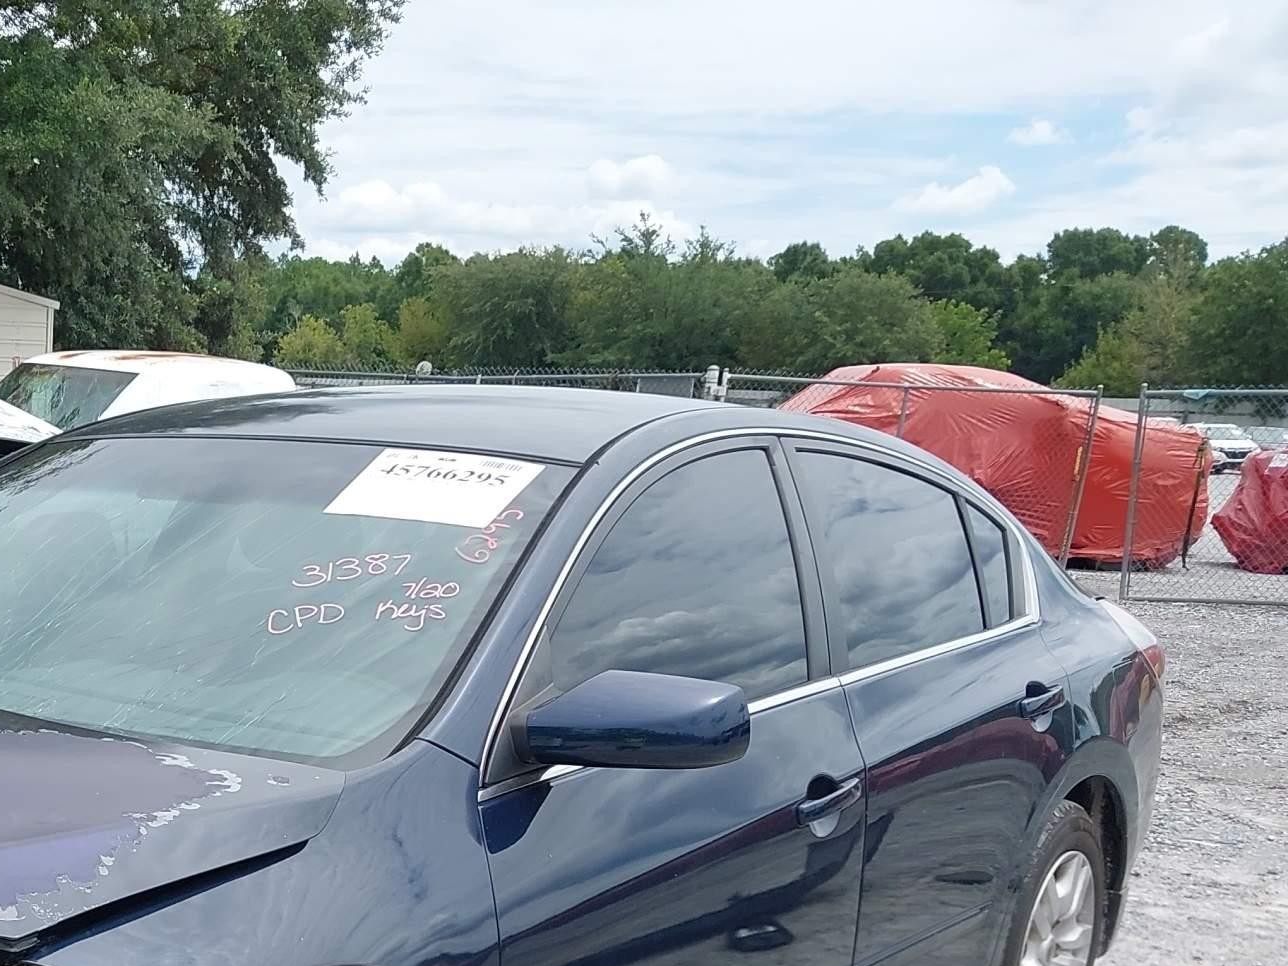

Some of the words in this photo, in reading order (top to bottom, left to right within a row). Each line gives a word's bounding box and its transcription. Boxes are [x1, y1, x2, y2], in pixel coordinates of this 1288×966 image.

[380, 463, 512, 486] 45766295
[292, 553, 412, 587] 31387
[402, 577, 460, 599] 7/20
[267, 603, 345, 634] CPD
[375, 600, 447, 631] Keys
